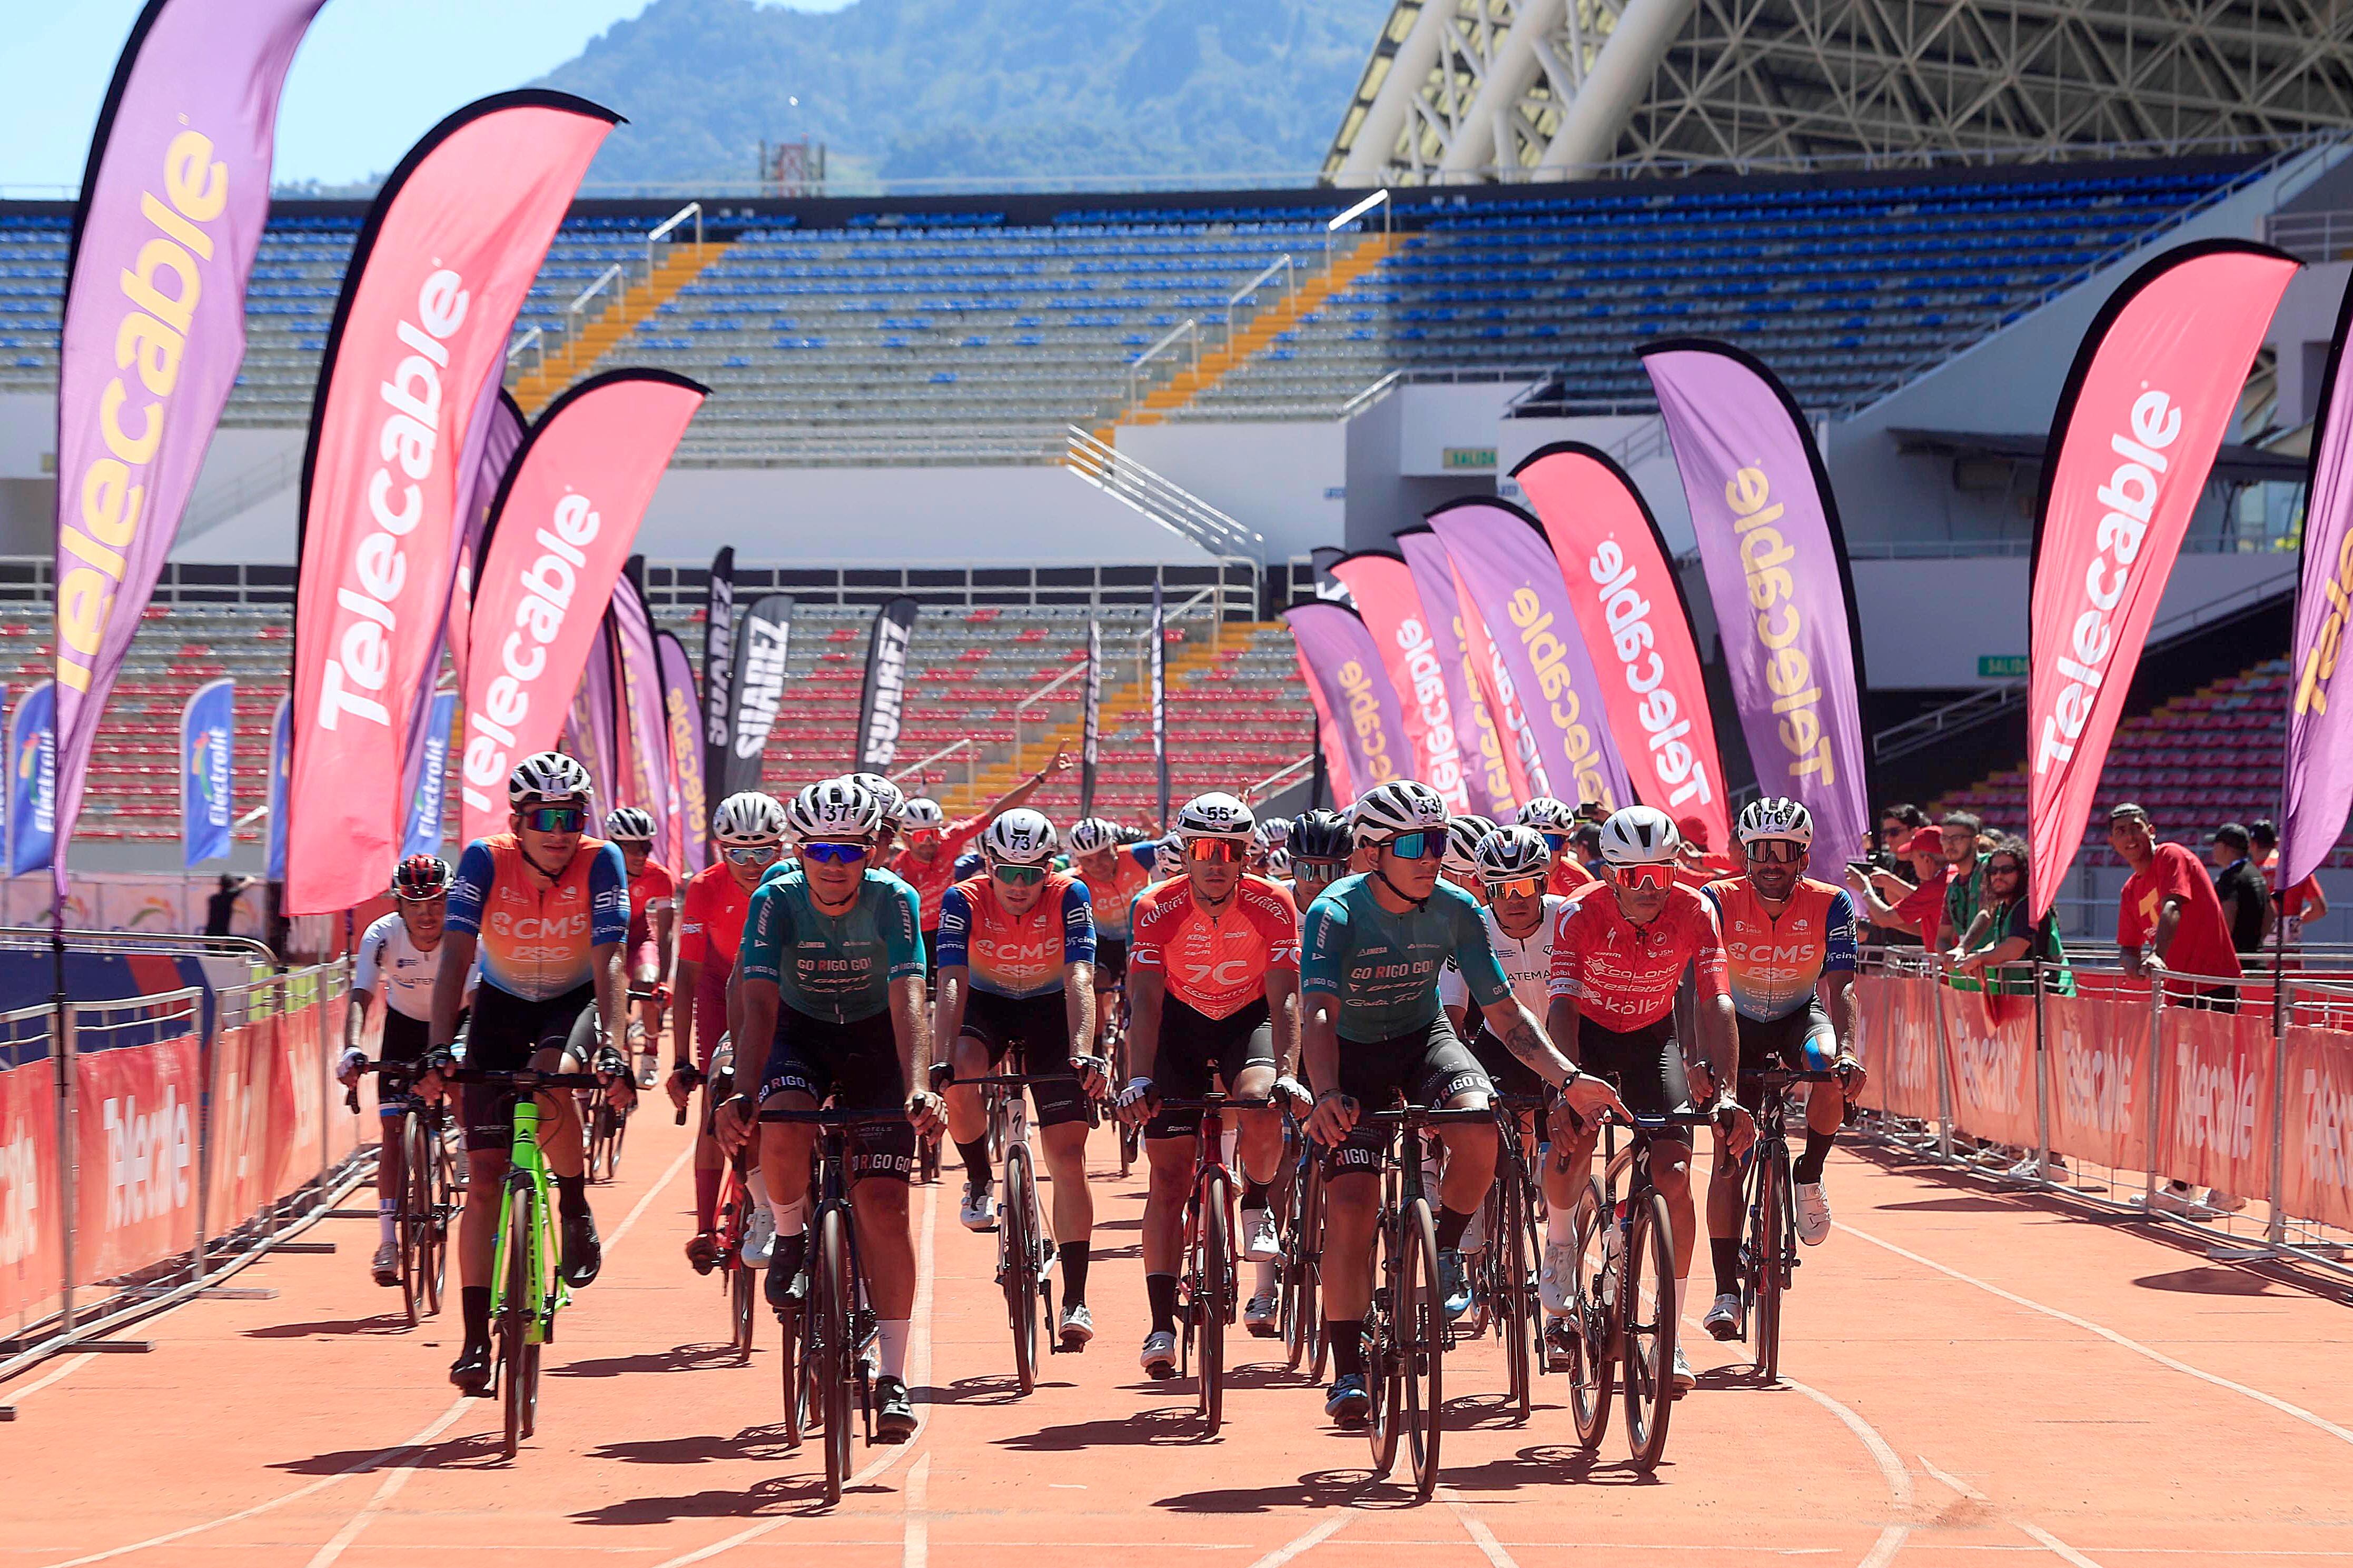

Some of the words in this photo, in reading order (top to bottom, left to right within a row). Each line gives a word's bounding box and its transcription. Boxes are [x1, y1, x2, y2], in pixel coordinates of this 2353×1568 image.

[319, 270, 469, 730] Telecable
[2036, 391, 2181, 774] Telecable
[708, 575, 733, 747] SUAREZ
[735, 615, 789, 759] SUAREZ
[864, 616, 911, 766] SUAREZ
[209, 727, 229, 827] Electrolit
[419, 736, 443, 838] Electrolit
[825, 804, 849, 821] 37
[1207, 806, 1229, 821] 55
[1764, 811, 1783, 825] 76
[1010, 835, 1031, 851] 73
[1240, 889, 1291, 925] Wilier
[513, 913, 588, 939] CMS
[898, 900, 912, 943] GIANT
[1317, 906, 1334, 949] GIANT
[996, 937, 1060, 960] CMS
[1749, 944, 1815, 964] CMS
[797, 959, 814, 971] GO
[818, 959, 846, 971] RIGO
[851, 957, 873, 971] GO!
[1185, 960, 1249, 985] 7C
[1351, 968, 1372, 980] GO
[1412, 960, 1434, 974] GO!
[1747, 967, 1798, 979] PSC
[1508, 970, 1550, 981] ATEMA
[1182, 983, 1252, 1000] Economy
[1492, 985, 1503, 996] GO
[1605, 994, 1666, 1015] kölbi
[771, 1076, 806, 1089] RIGO
[895, 1156, 912, 1173] GO
[1336, 1148, 1369, 1167] RIGO
